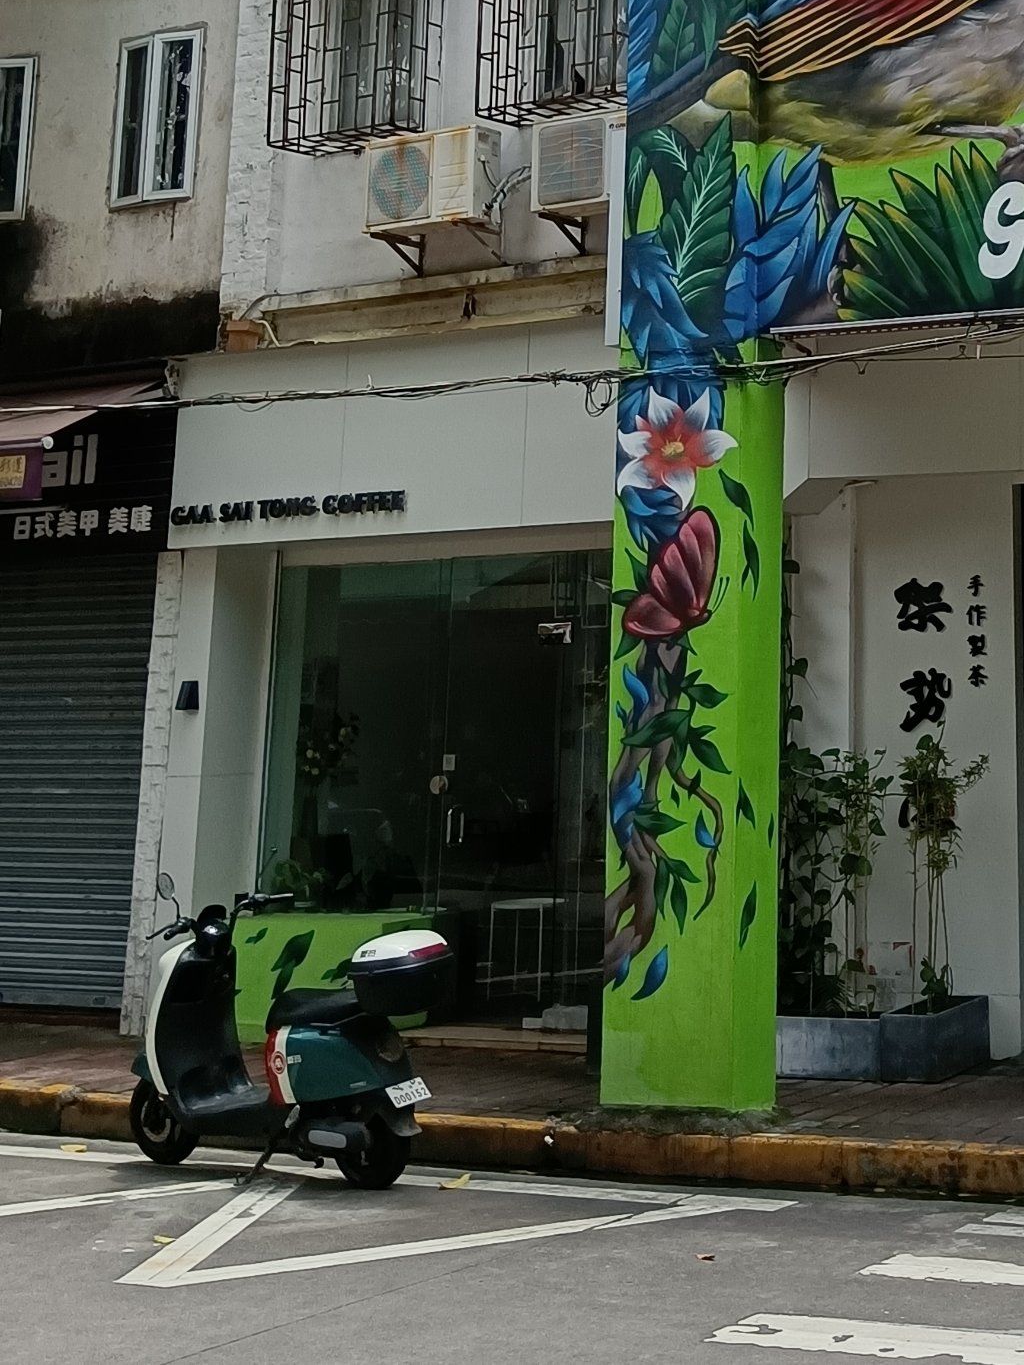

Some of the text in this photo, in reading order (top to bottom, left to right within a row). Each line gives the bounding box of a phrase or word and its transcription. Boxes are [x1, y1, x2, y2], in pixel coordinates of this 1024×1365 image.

[219, 501, 254, 523] SAI
[258, 496, 320, 522] TONG
[322, 490, 406, 516] COFFEE
[13, 509, 99, 540] 日式美甲
